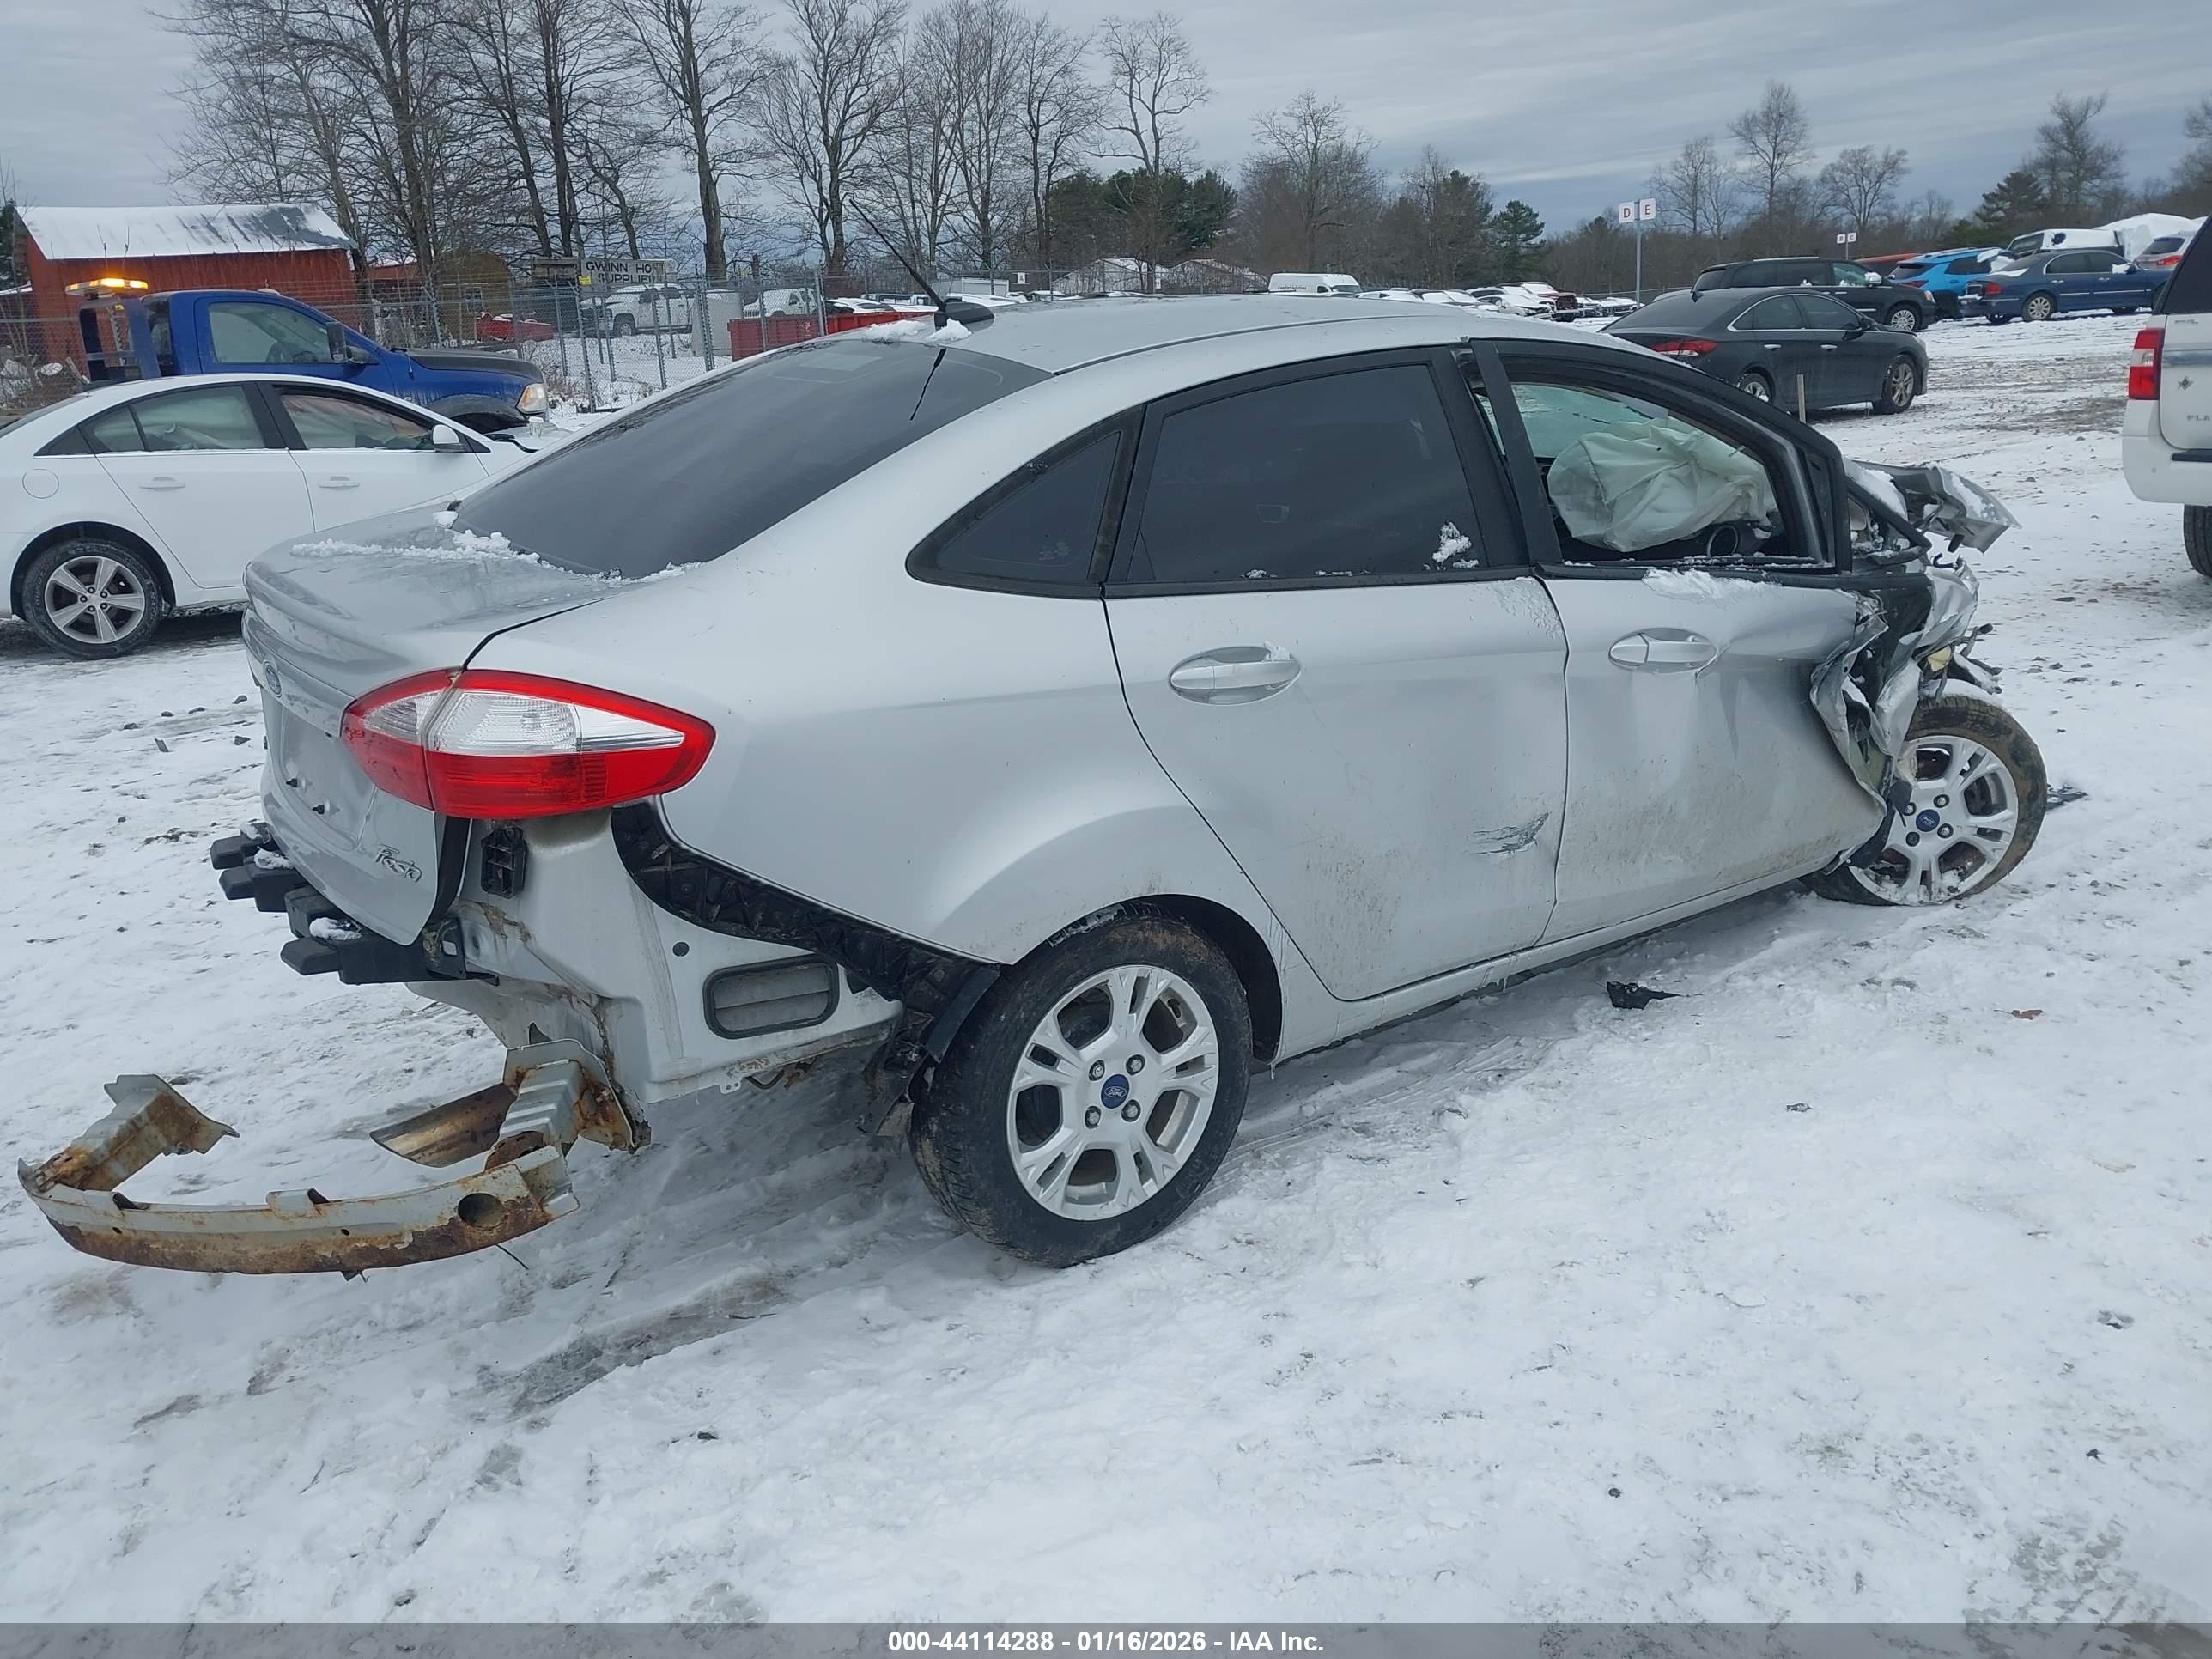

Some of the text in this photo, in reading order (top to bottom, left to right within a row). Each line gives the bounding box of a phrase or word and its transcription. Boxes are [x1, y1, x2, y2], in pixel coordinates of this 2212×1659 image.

[1623, 207, 1631, 218] D
[1644, 204, 1650, 215] E
[586, 261, 628, 273] GWINN
